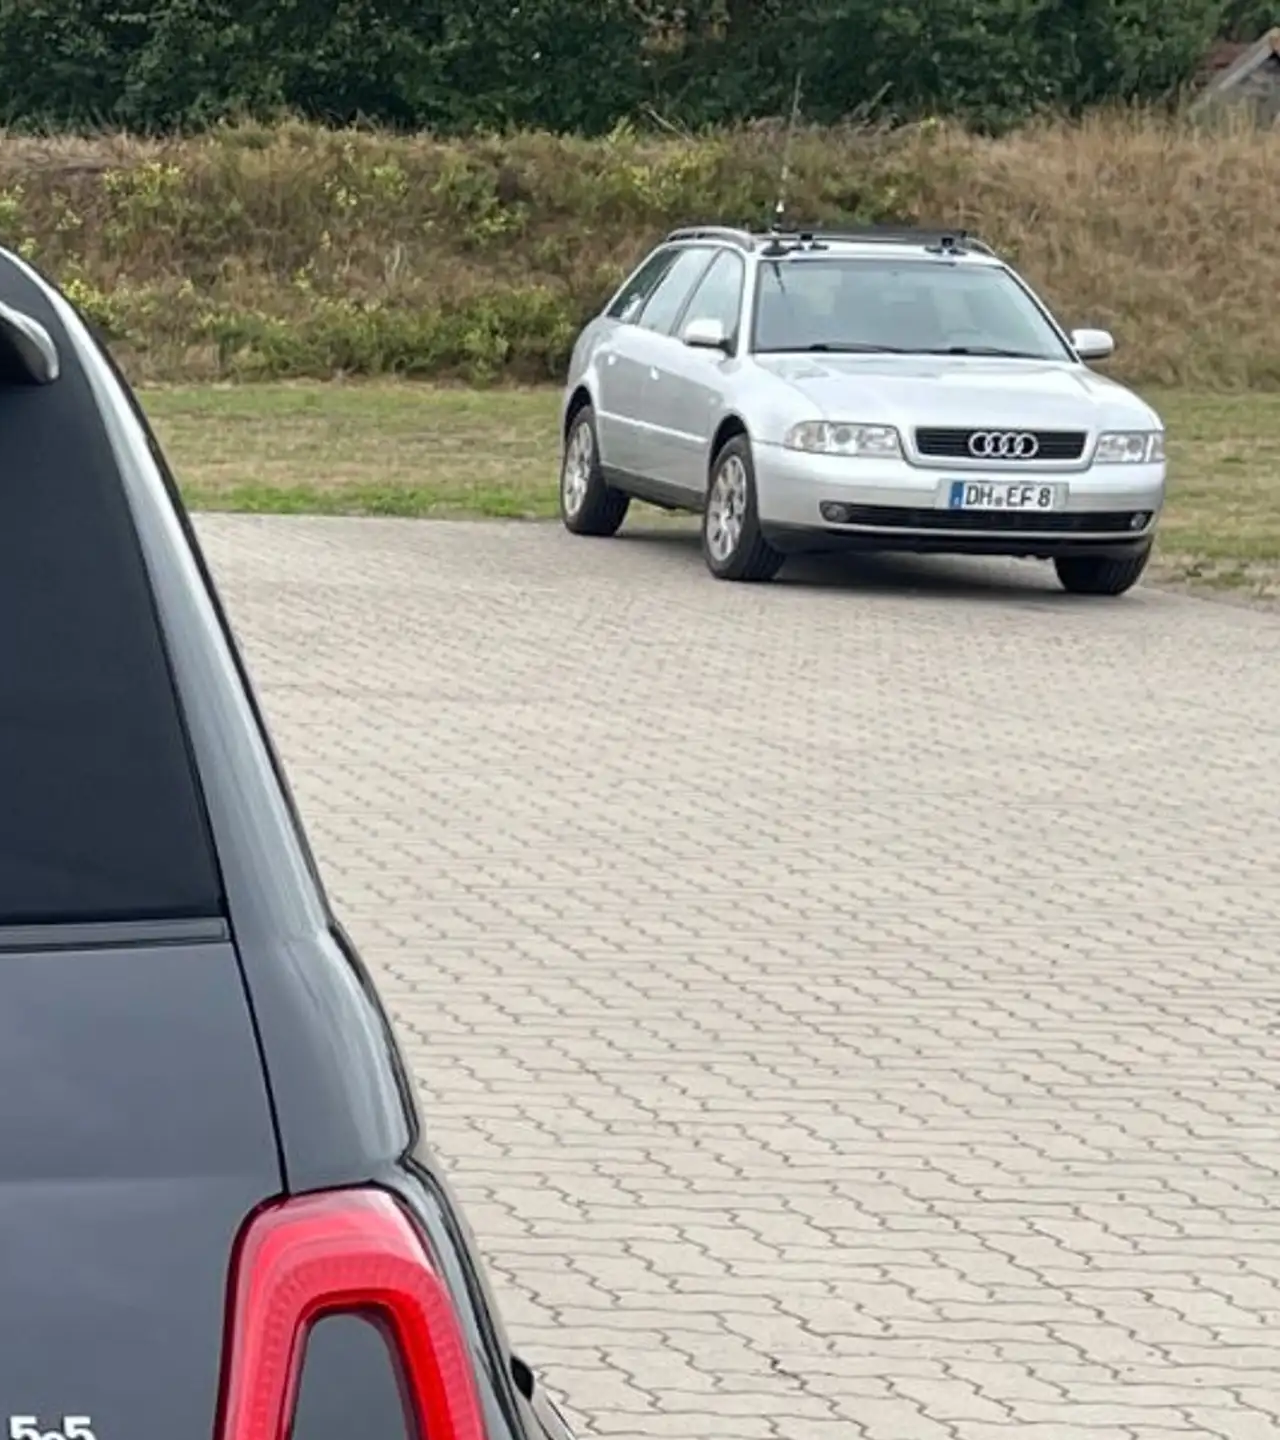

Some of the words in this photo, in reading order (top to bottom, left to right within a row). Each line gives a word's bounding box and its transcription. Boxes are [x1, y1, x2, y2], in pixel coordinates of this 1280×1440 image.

[965, 485, 995, 506] DH
[1006, 486, 1035, 508] EF
[1037, 487, 1052, 508] 8
